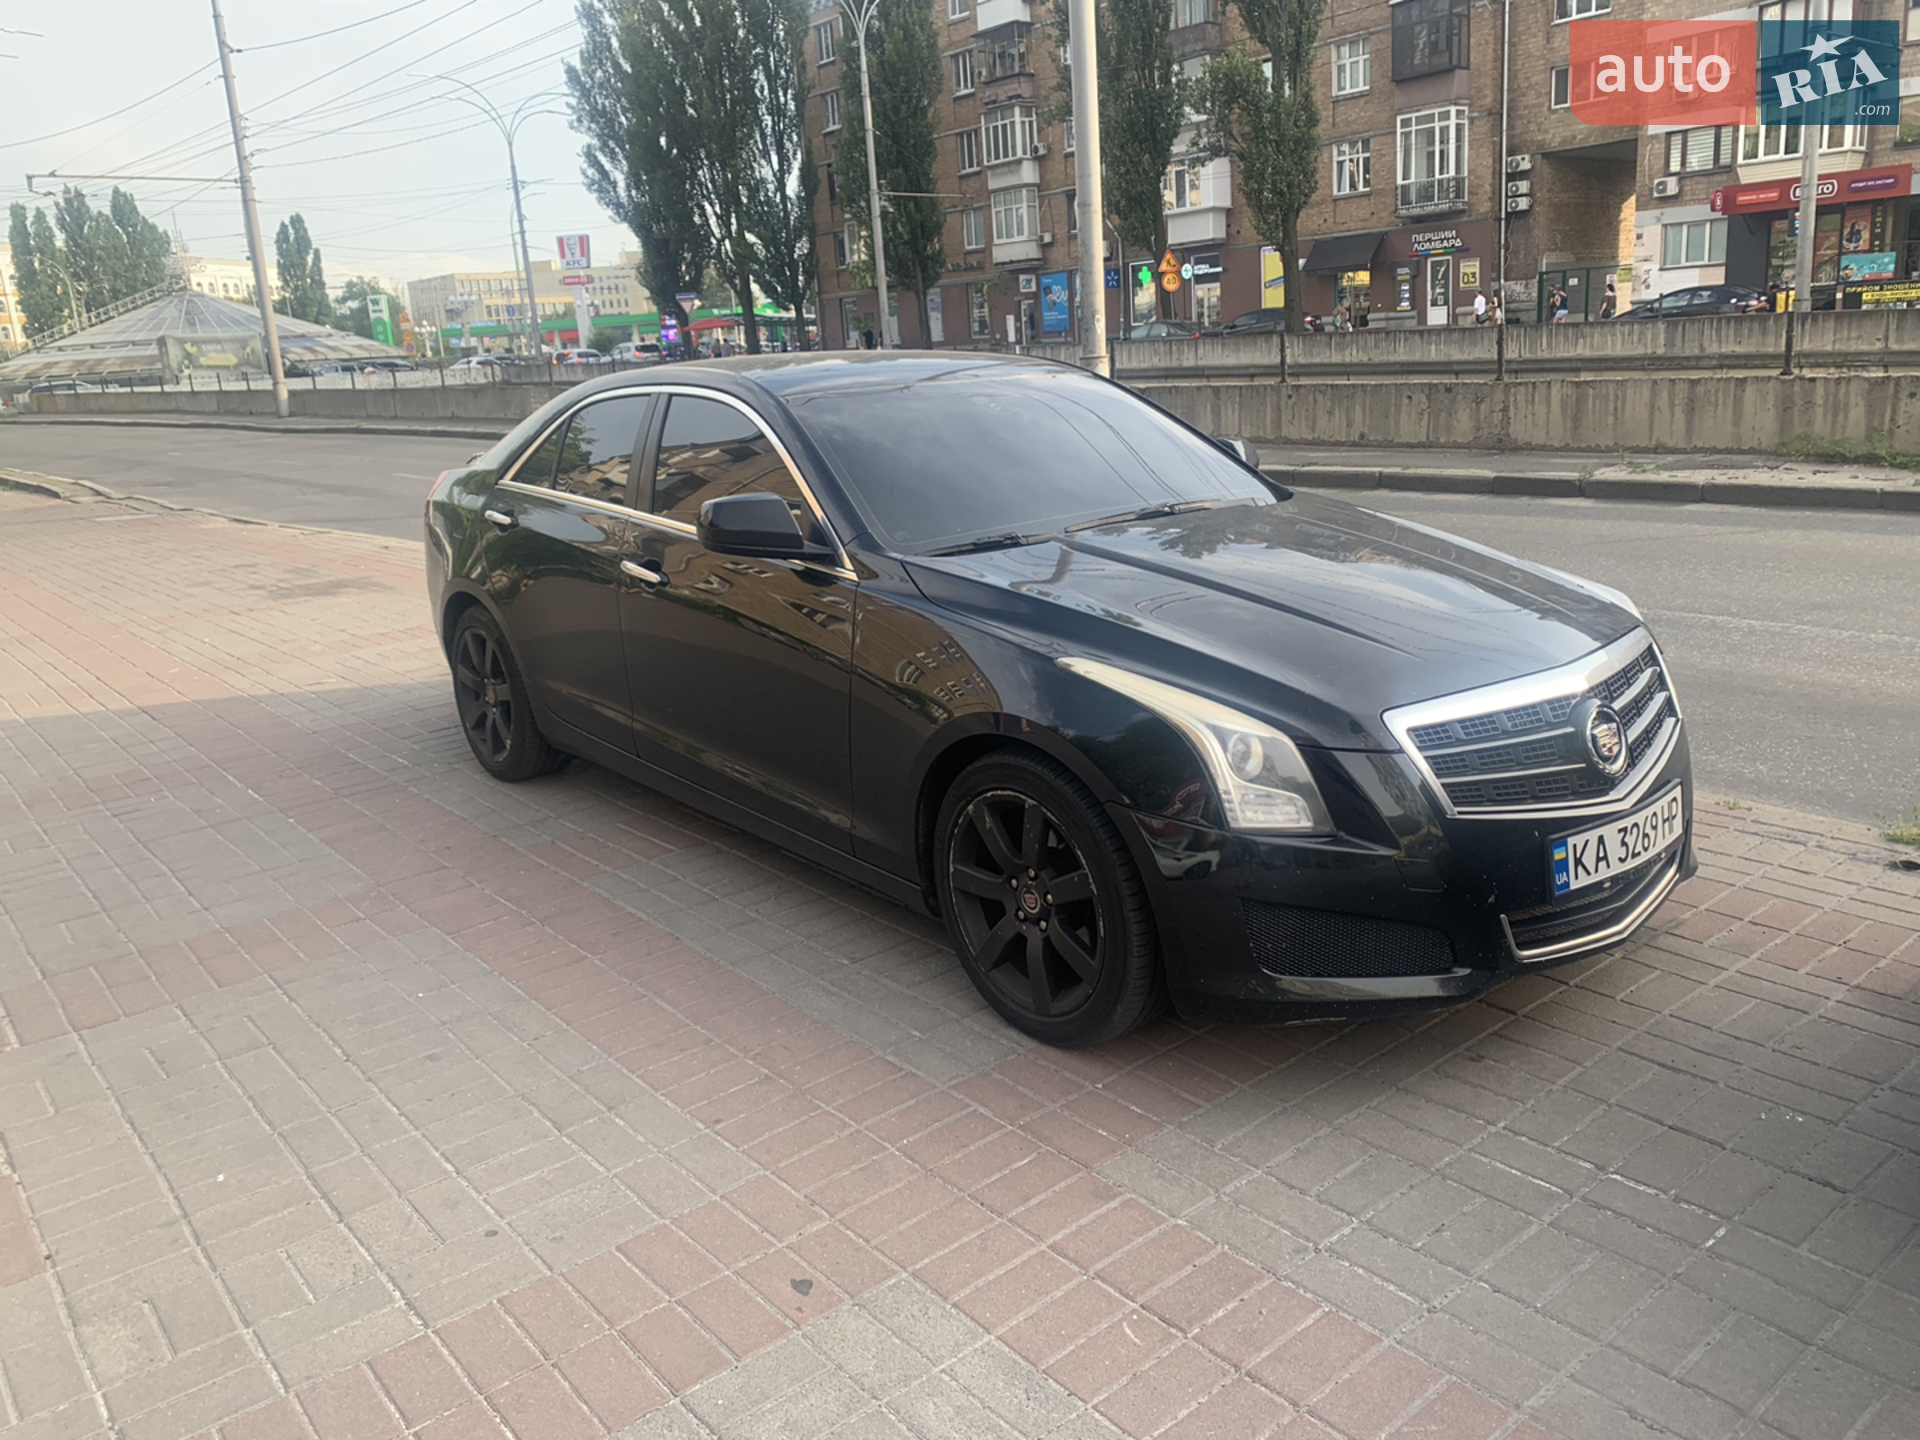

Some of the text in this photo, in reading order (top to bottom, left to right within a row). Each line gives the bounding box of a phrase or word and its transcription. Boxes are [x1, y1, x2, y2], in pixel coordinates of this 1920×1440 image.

[1412, 238, 1463, 251] ЛОМБАРД
[566, 259, 583, 267] KFC
[1166, 276, 1177, 285] 40
[1572, 834, 1611, 881] KA
[1617, 811, 1659, 864] 3269
[1661, 796, 1679, 840] HP
[1555, 871, 1569, 886] UA
